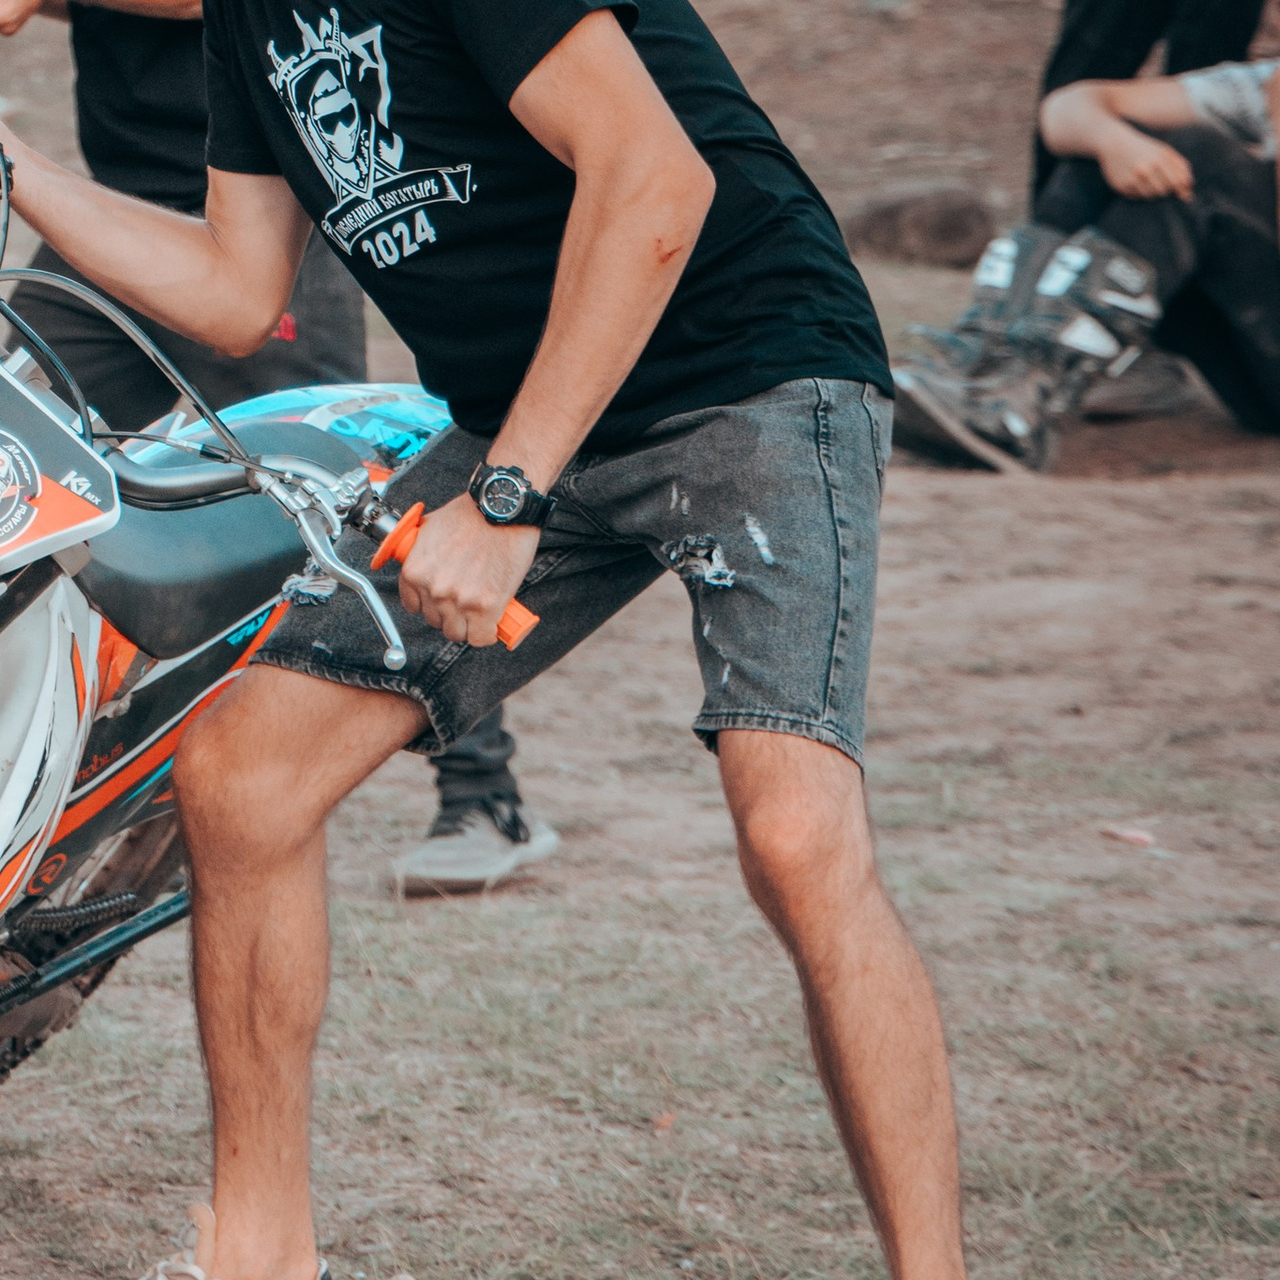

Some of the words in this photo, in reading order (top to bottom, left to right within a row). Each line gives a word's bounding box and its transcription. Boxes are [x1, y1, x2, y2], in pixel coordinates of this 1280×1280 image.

[378, 178, 439, 210] БОГАТЫРЬ
[361, 209, 437, 269] 2024
[83, 491, 102, 506] MX
